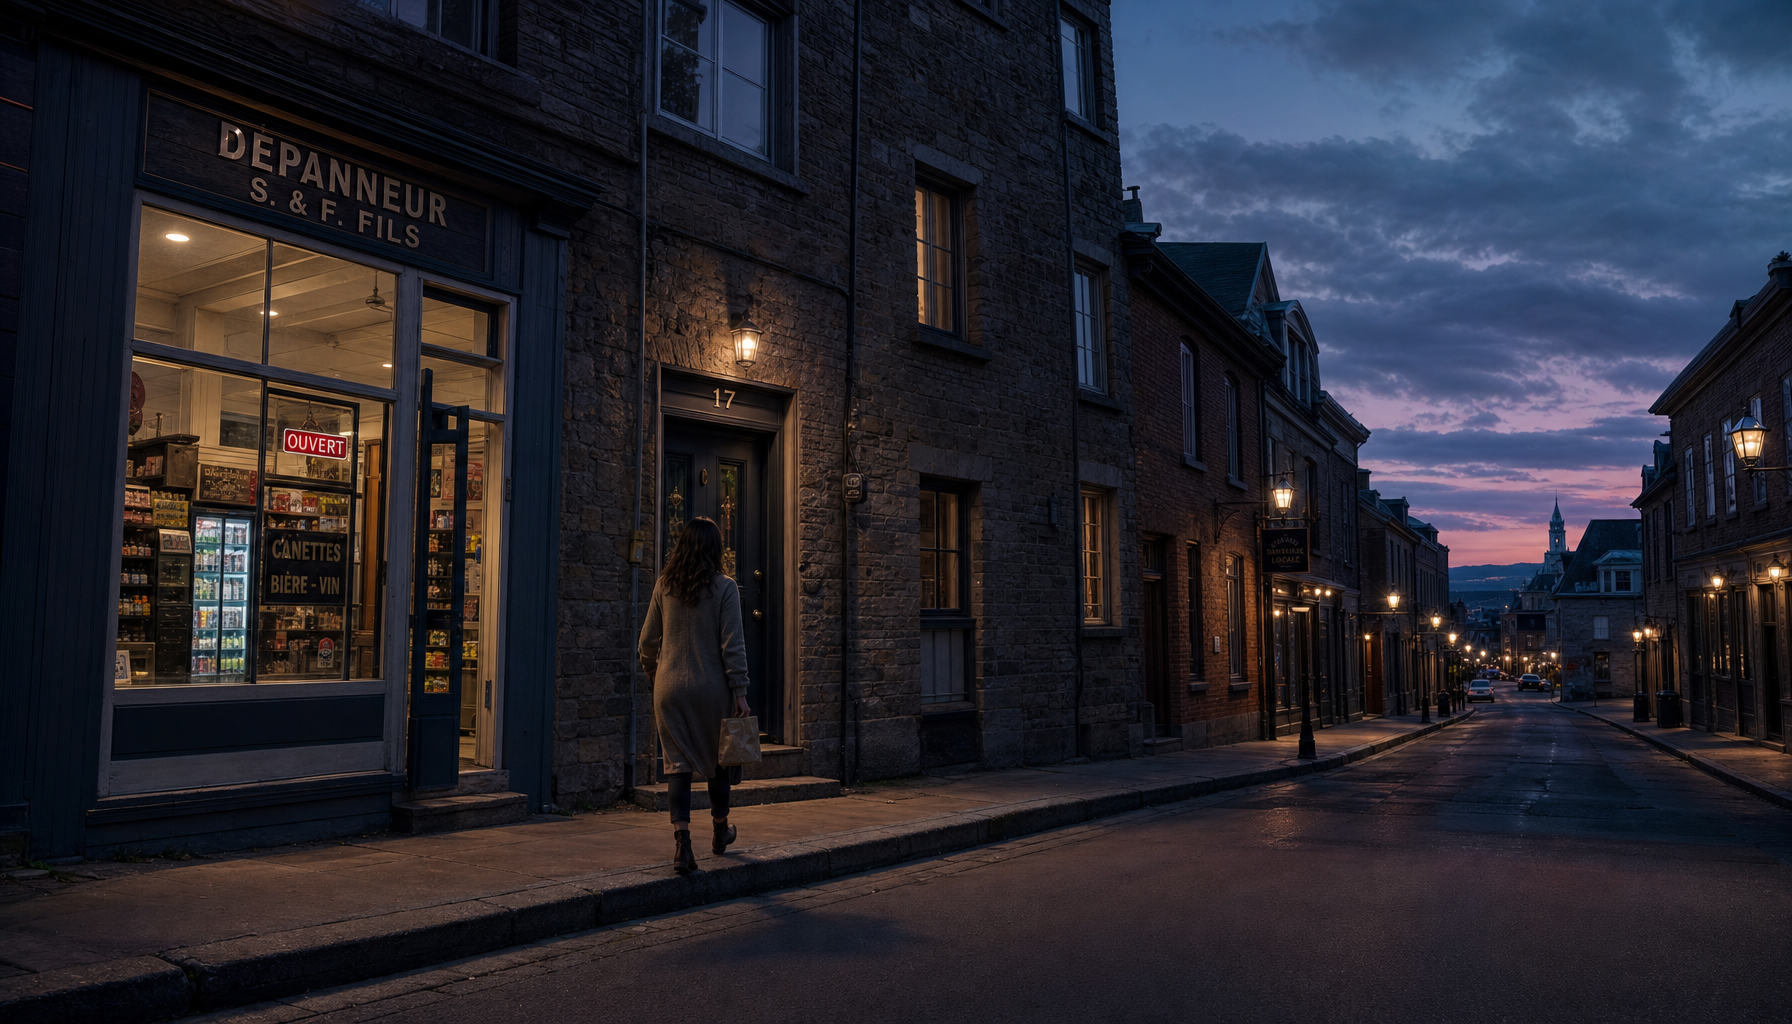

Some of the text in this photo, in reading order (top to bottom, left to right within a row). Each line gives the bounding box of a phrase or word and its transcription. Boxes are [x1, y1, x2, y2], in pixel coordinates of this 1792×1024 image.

[249, 176, 420, 249] S. & F. FILS
[713, 388, 736, 409] 17
[287, 433, 345, 455] OUVERT
[271, 538, 342, 563] CANETTES
[319, 576, 340, 595] VIN
